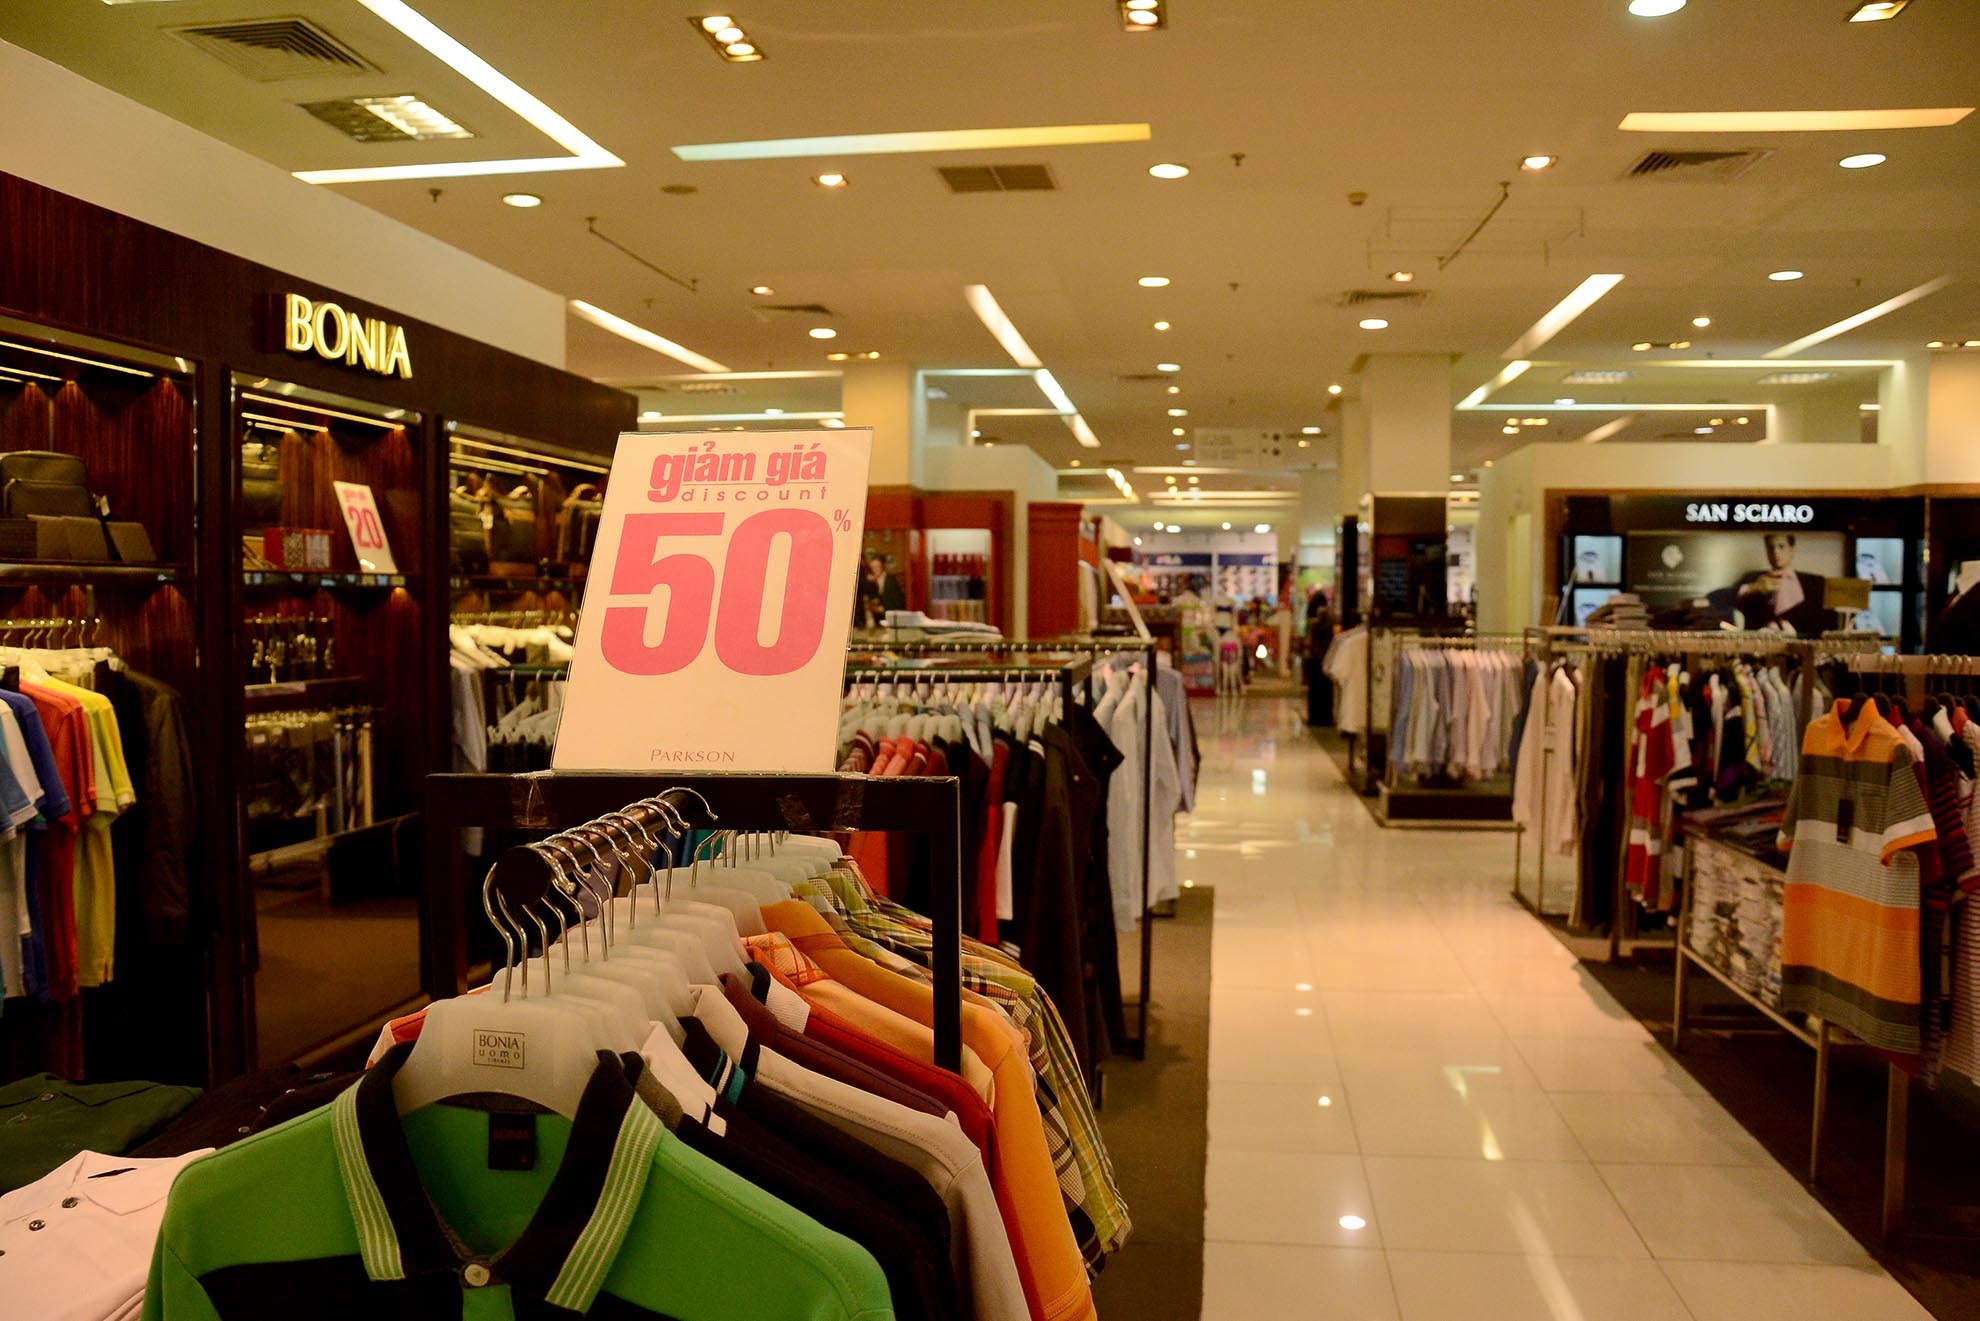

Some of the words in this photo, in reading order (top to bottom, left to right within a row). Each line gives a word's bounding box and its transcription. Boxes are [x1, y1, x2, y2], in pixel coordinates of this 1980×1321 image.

[285, 292, 414, 380] BONIA
[648, 441, 757, 503] giảm
[765, 443, 828, 487] giá
[681, 486, 828, 502] discount
[1685, 503, 1729, 522] SAN
[1733, 503, 1814, 523] SCIARO
[347, 505, 383, 550] 20
[650, 748, 736, 764] PARKSON
[479, 1034, 520, 1050] BONIA
[479, 1049, 520, 1060] uomo
